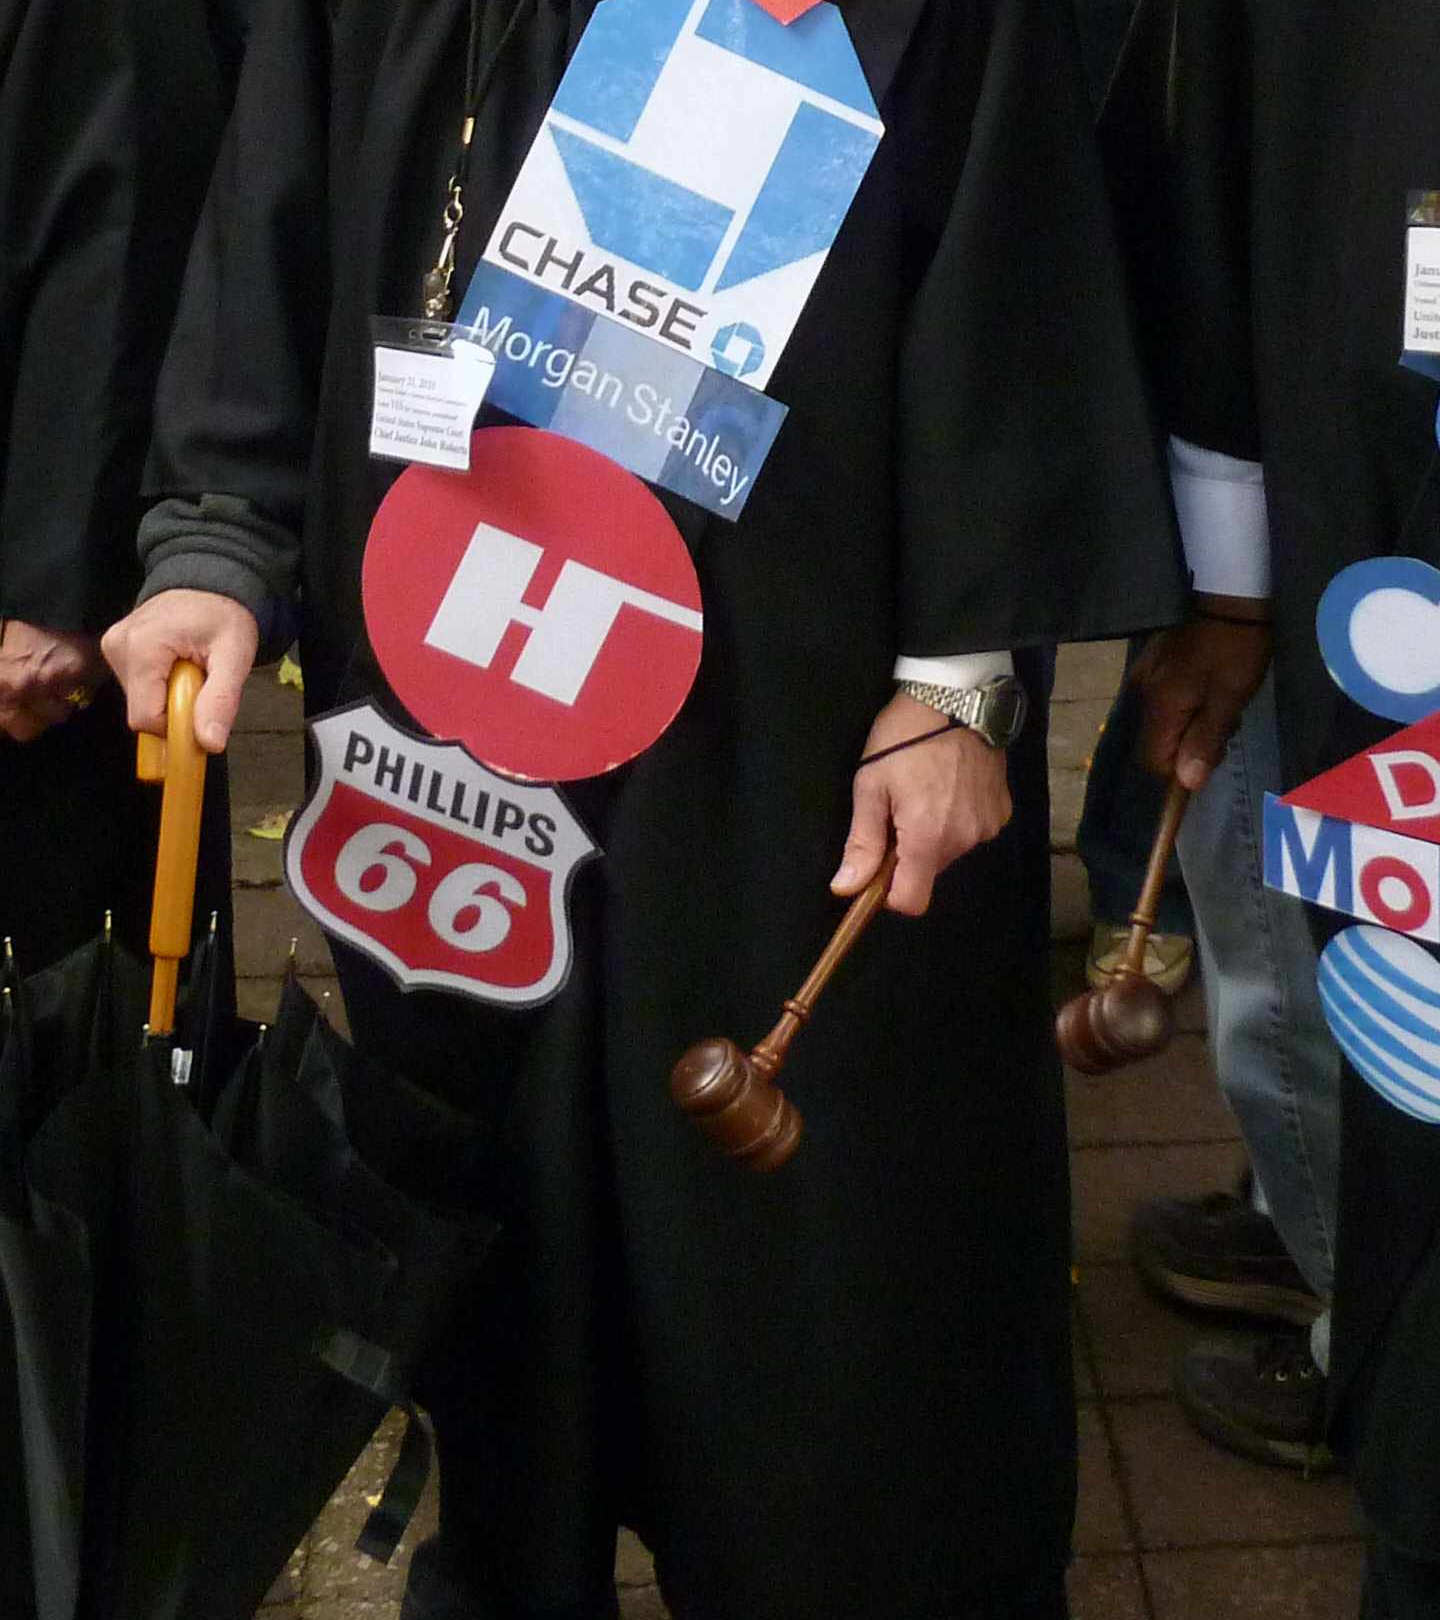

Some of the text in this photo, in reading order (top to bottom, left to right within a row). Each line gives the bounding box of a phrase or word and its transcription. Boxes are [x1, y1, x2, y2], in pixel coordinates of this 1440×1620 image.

[498, 220, 708, 350] CHASE
[464, 305, 749, 507] Morgan Stanley
[343, 730, 558, 858] PHILLIPS
[335, 823, 527, 953] 66
